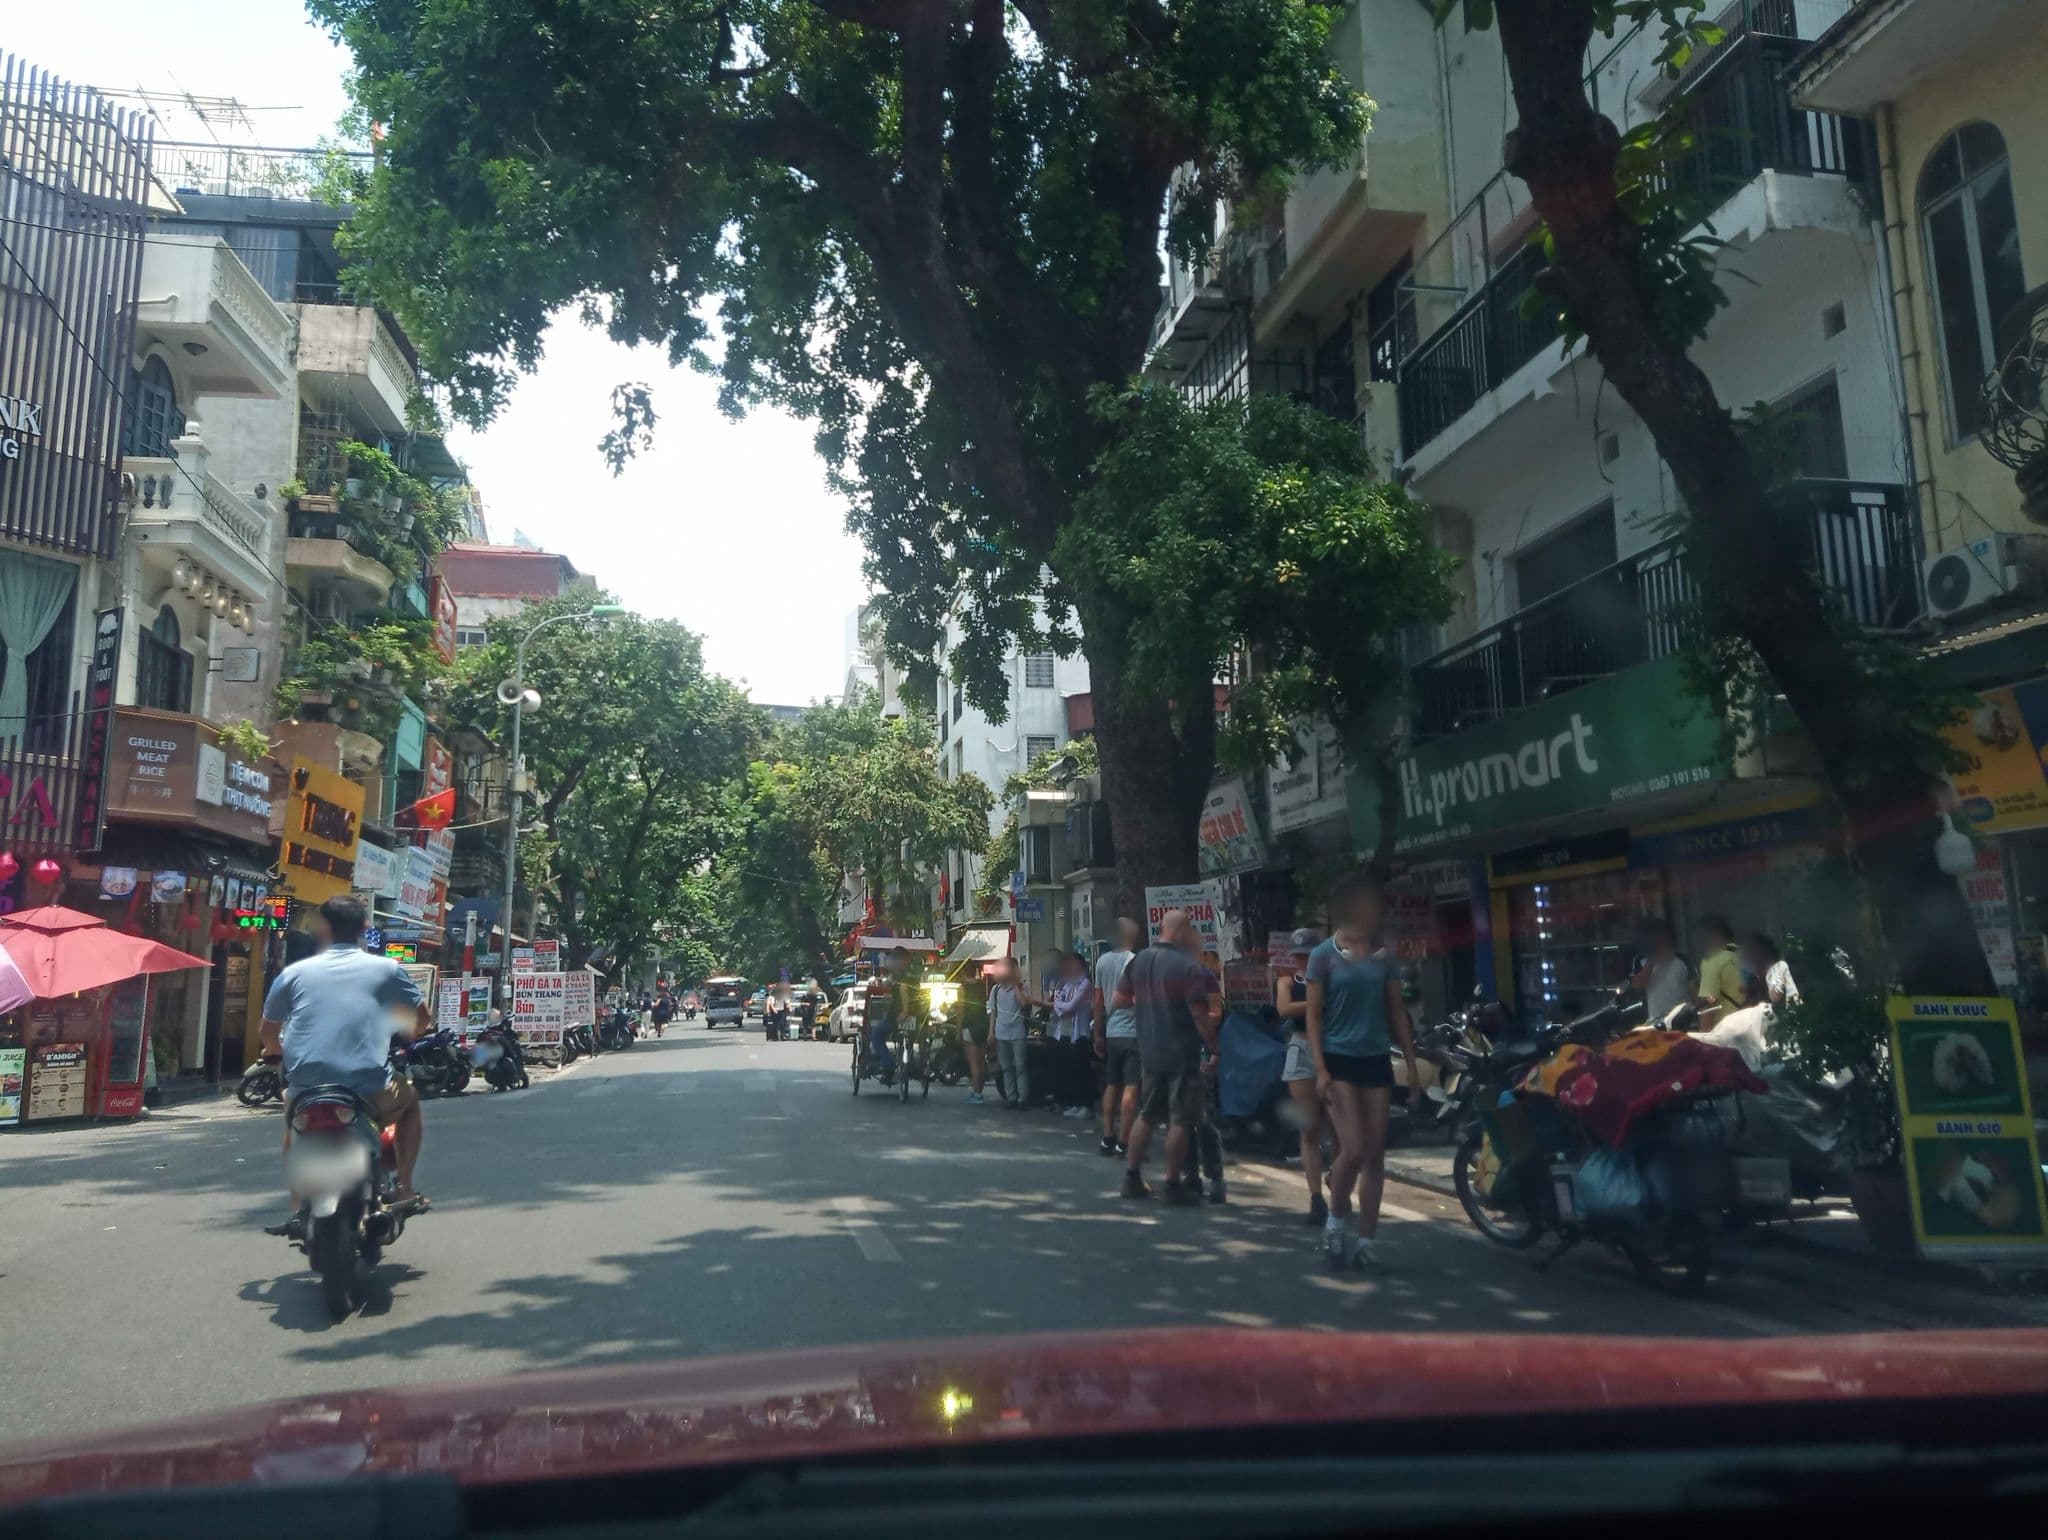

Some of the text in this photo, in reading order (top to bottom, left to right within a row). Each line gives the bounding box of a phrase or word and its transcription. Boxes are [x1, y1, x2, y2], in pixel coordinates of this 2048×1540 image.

[95, 668, 112, 683] FOOT
[128, 736, 177, 751] GRILLED
[137, 751, 171, 764] MEAT
[139, 765, 167, 777] RICE
[552, 978, 563, 989] TA
[534, 991, 562, 999] THANG
[515, 999, 535, 1014] Bún
[3, 1053, 24, 1062] JUICE
